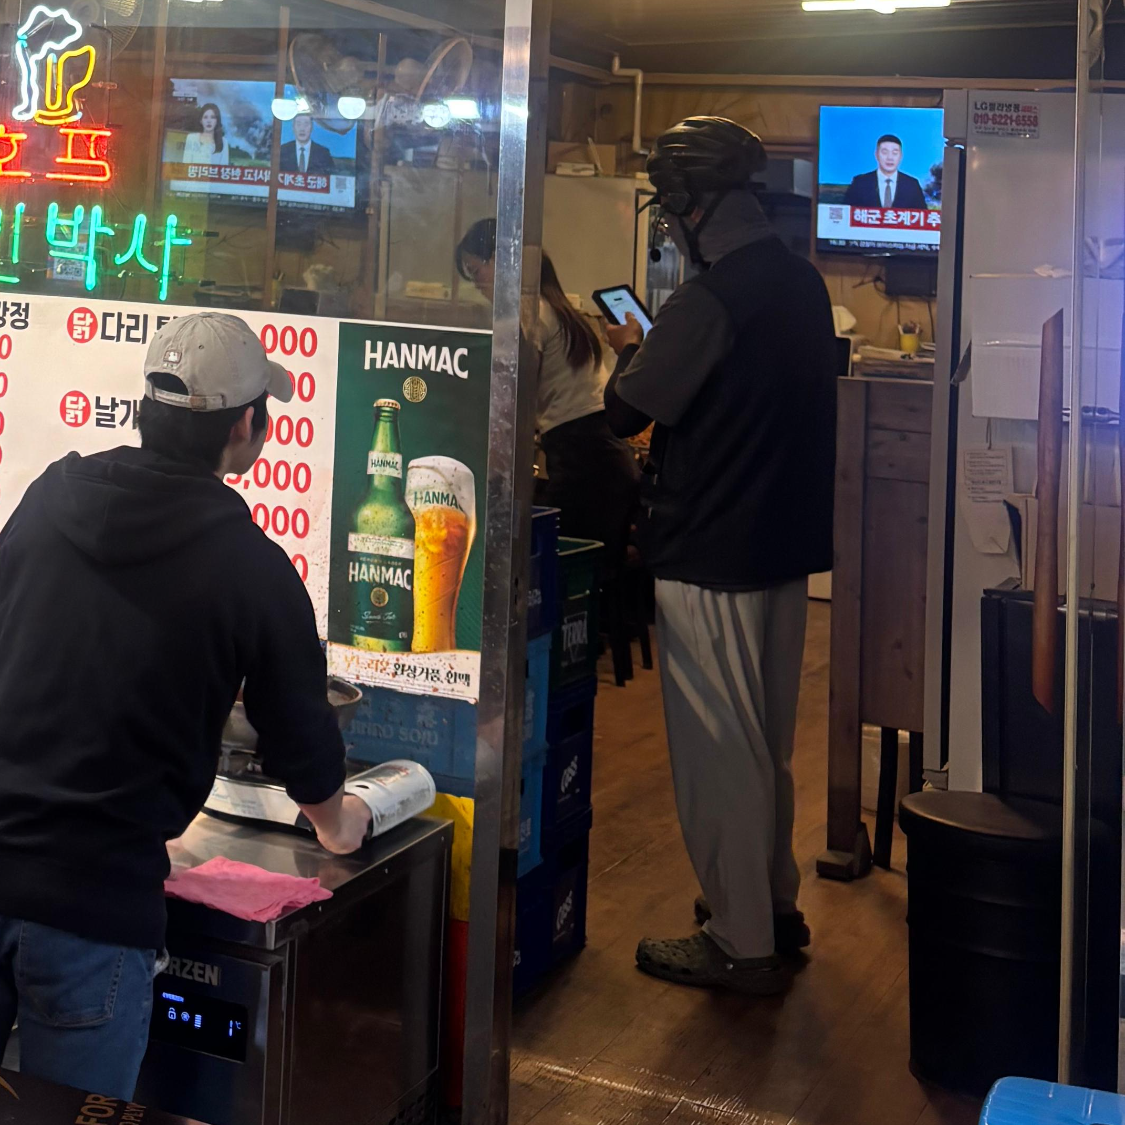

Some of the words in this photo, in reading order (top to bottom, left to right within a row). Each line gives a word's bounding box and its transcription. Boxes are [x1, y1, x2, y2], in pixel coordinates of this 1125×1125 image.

[853, 208, 882, 225] 해군
[882, 209, 925, 227] 초계기
[71, 310, 93, 340] 닭
[100, 311, 149, 344] 다리
[363, 339, 469, 380] HANMAC
[65, 393, 87, 424] 닭
[226, 457, 312, 494] ,000
[370, 458, 399, 470] HANMAC
[348, 561, 412, 591] HANMAC
[165, 955, 220, 986] RZEN
